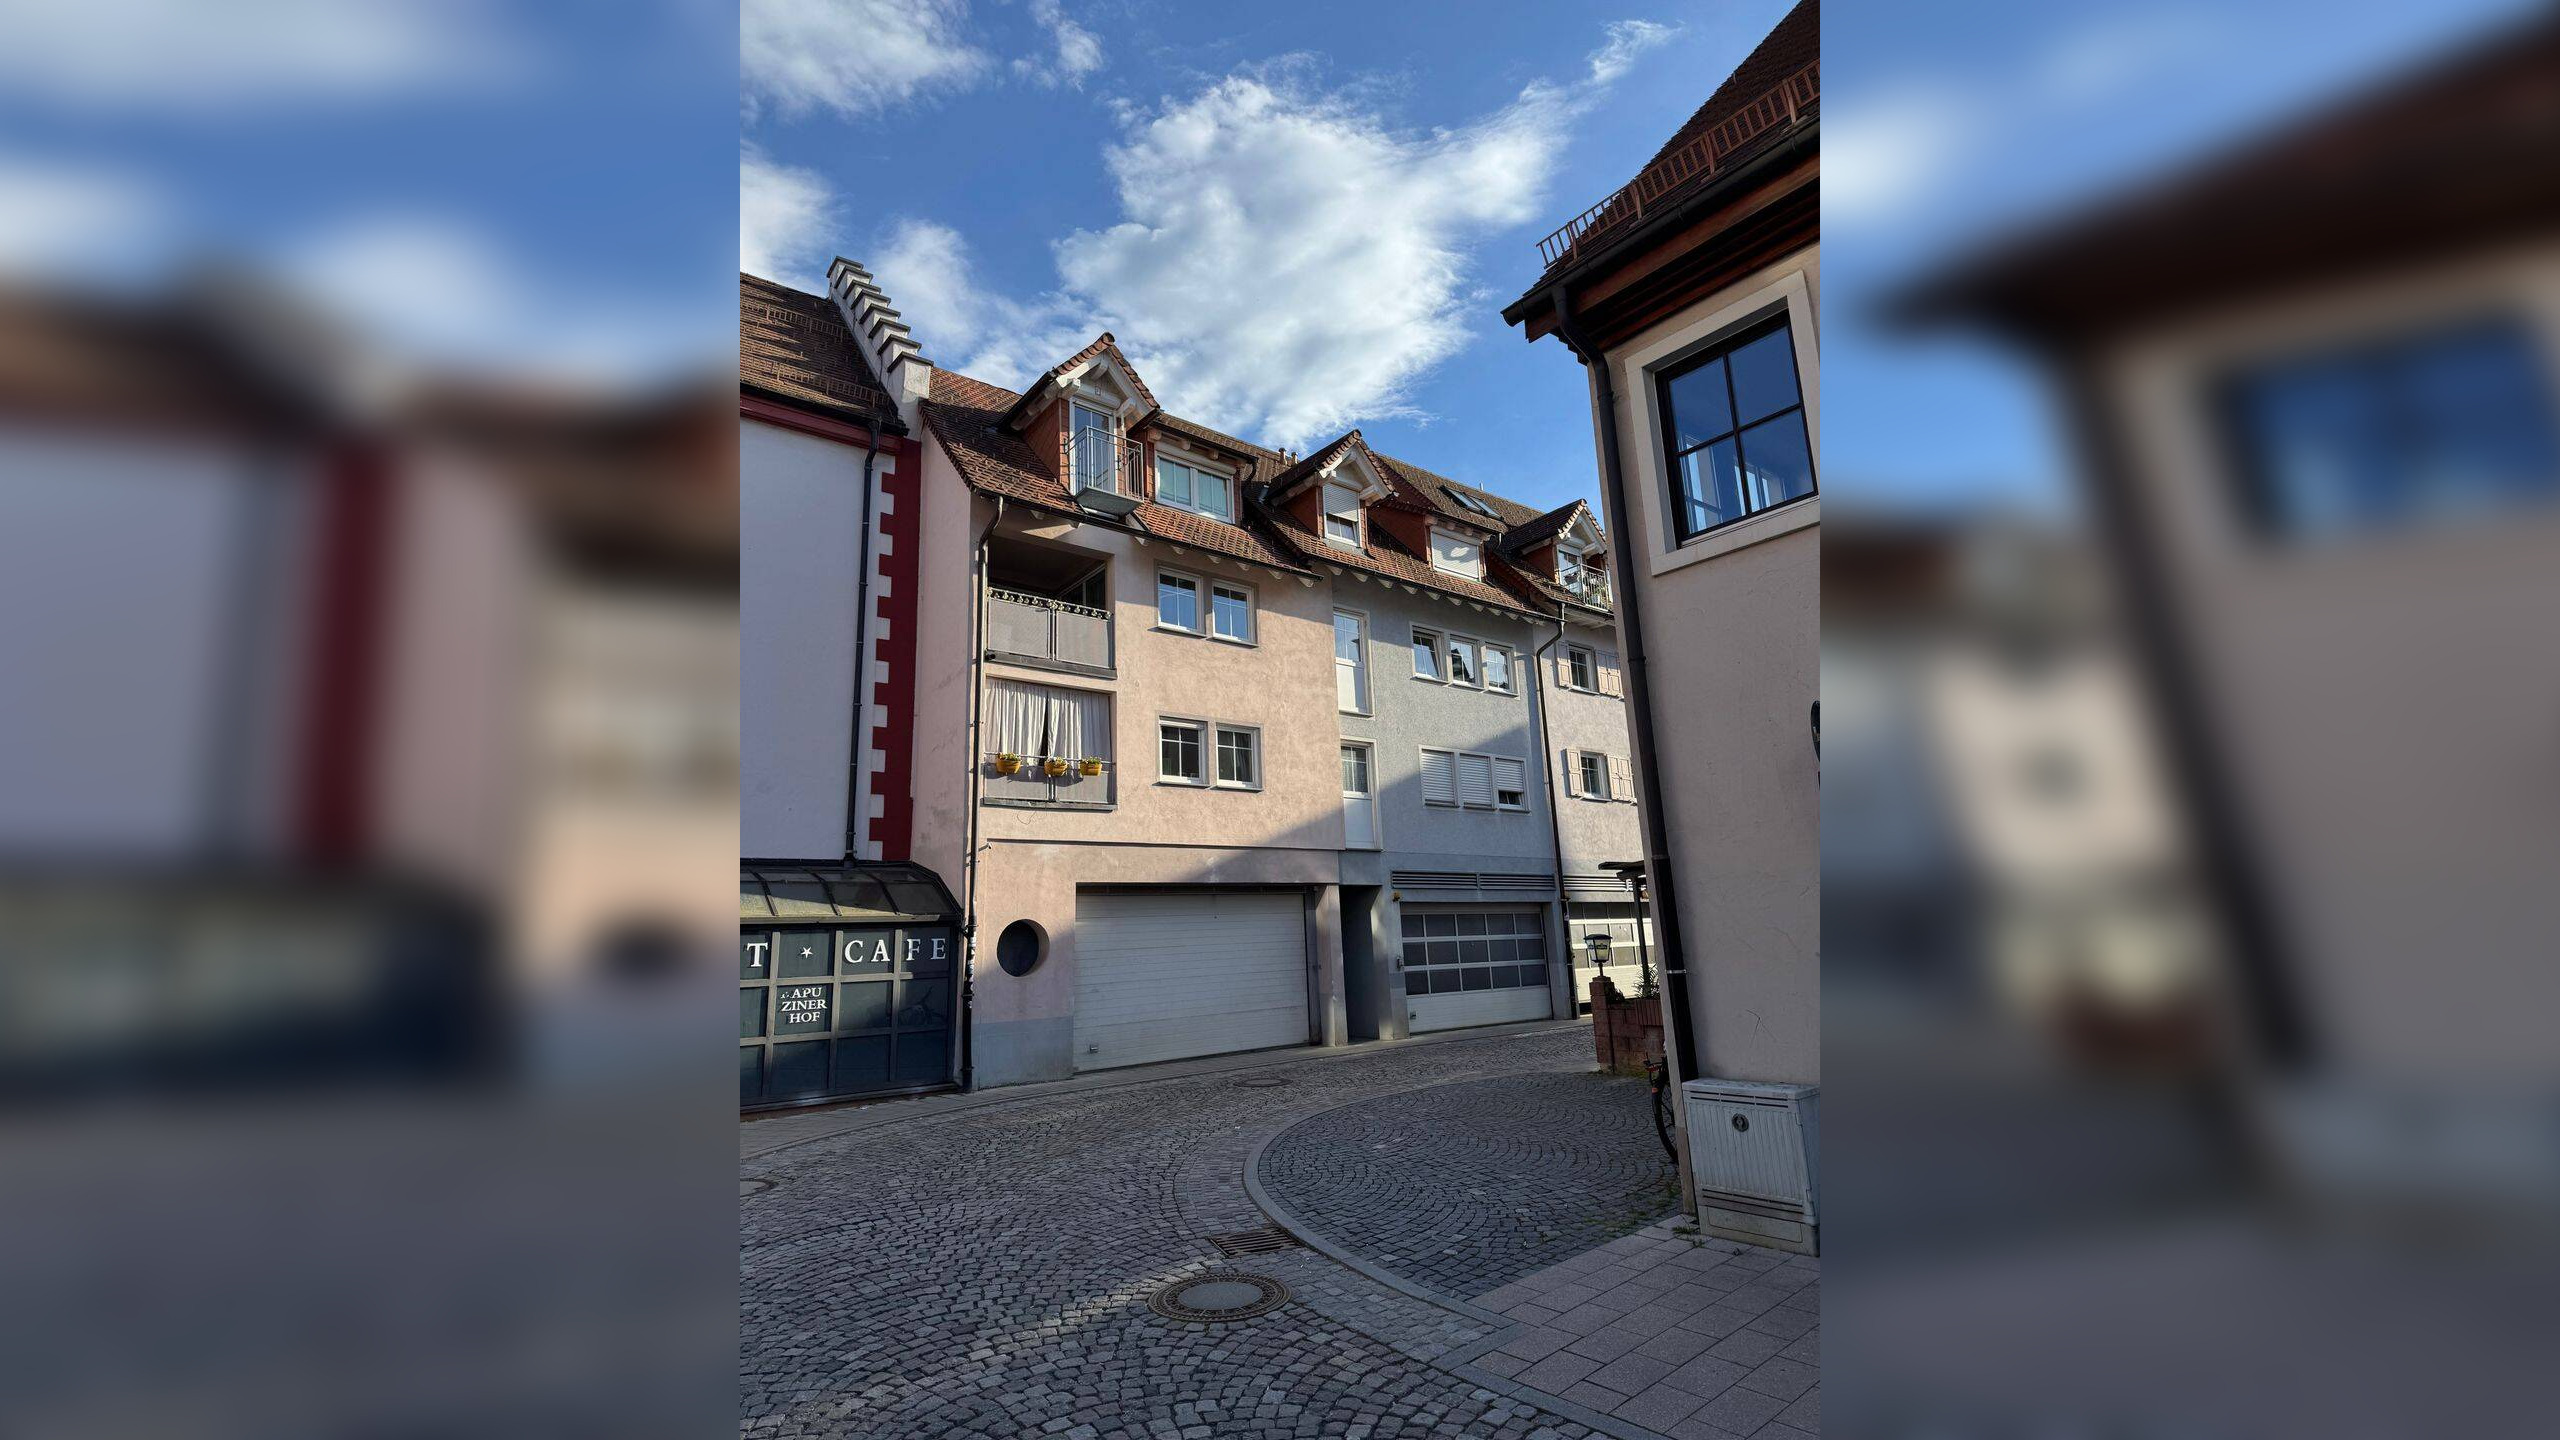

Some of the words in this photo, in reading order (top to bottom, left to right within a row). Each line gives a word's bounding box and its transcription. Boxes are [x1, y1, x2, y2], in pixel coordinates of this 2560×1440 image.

[844, 938, 946, 963] CAFE
[781, 999, 828, 1011] ZINER
[789, 1011, 821, 1023] HOF
